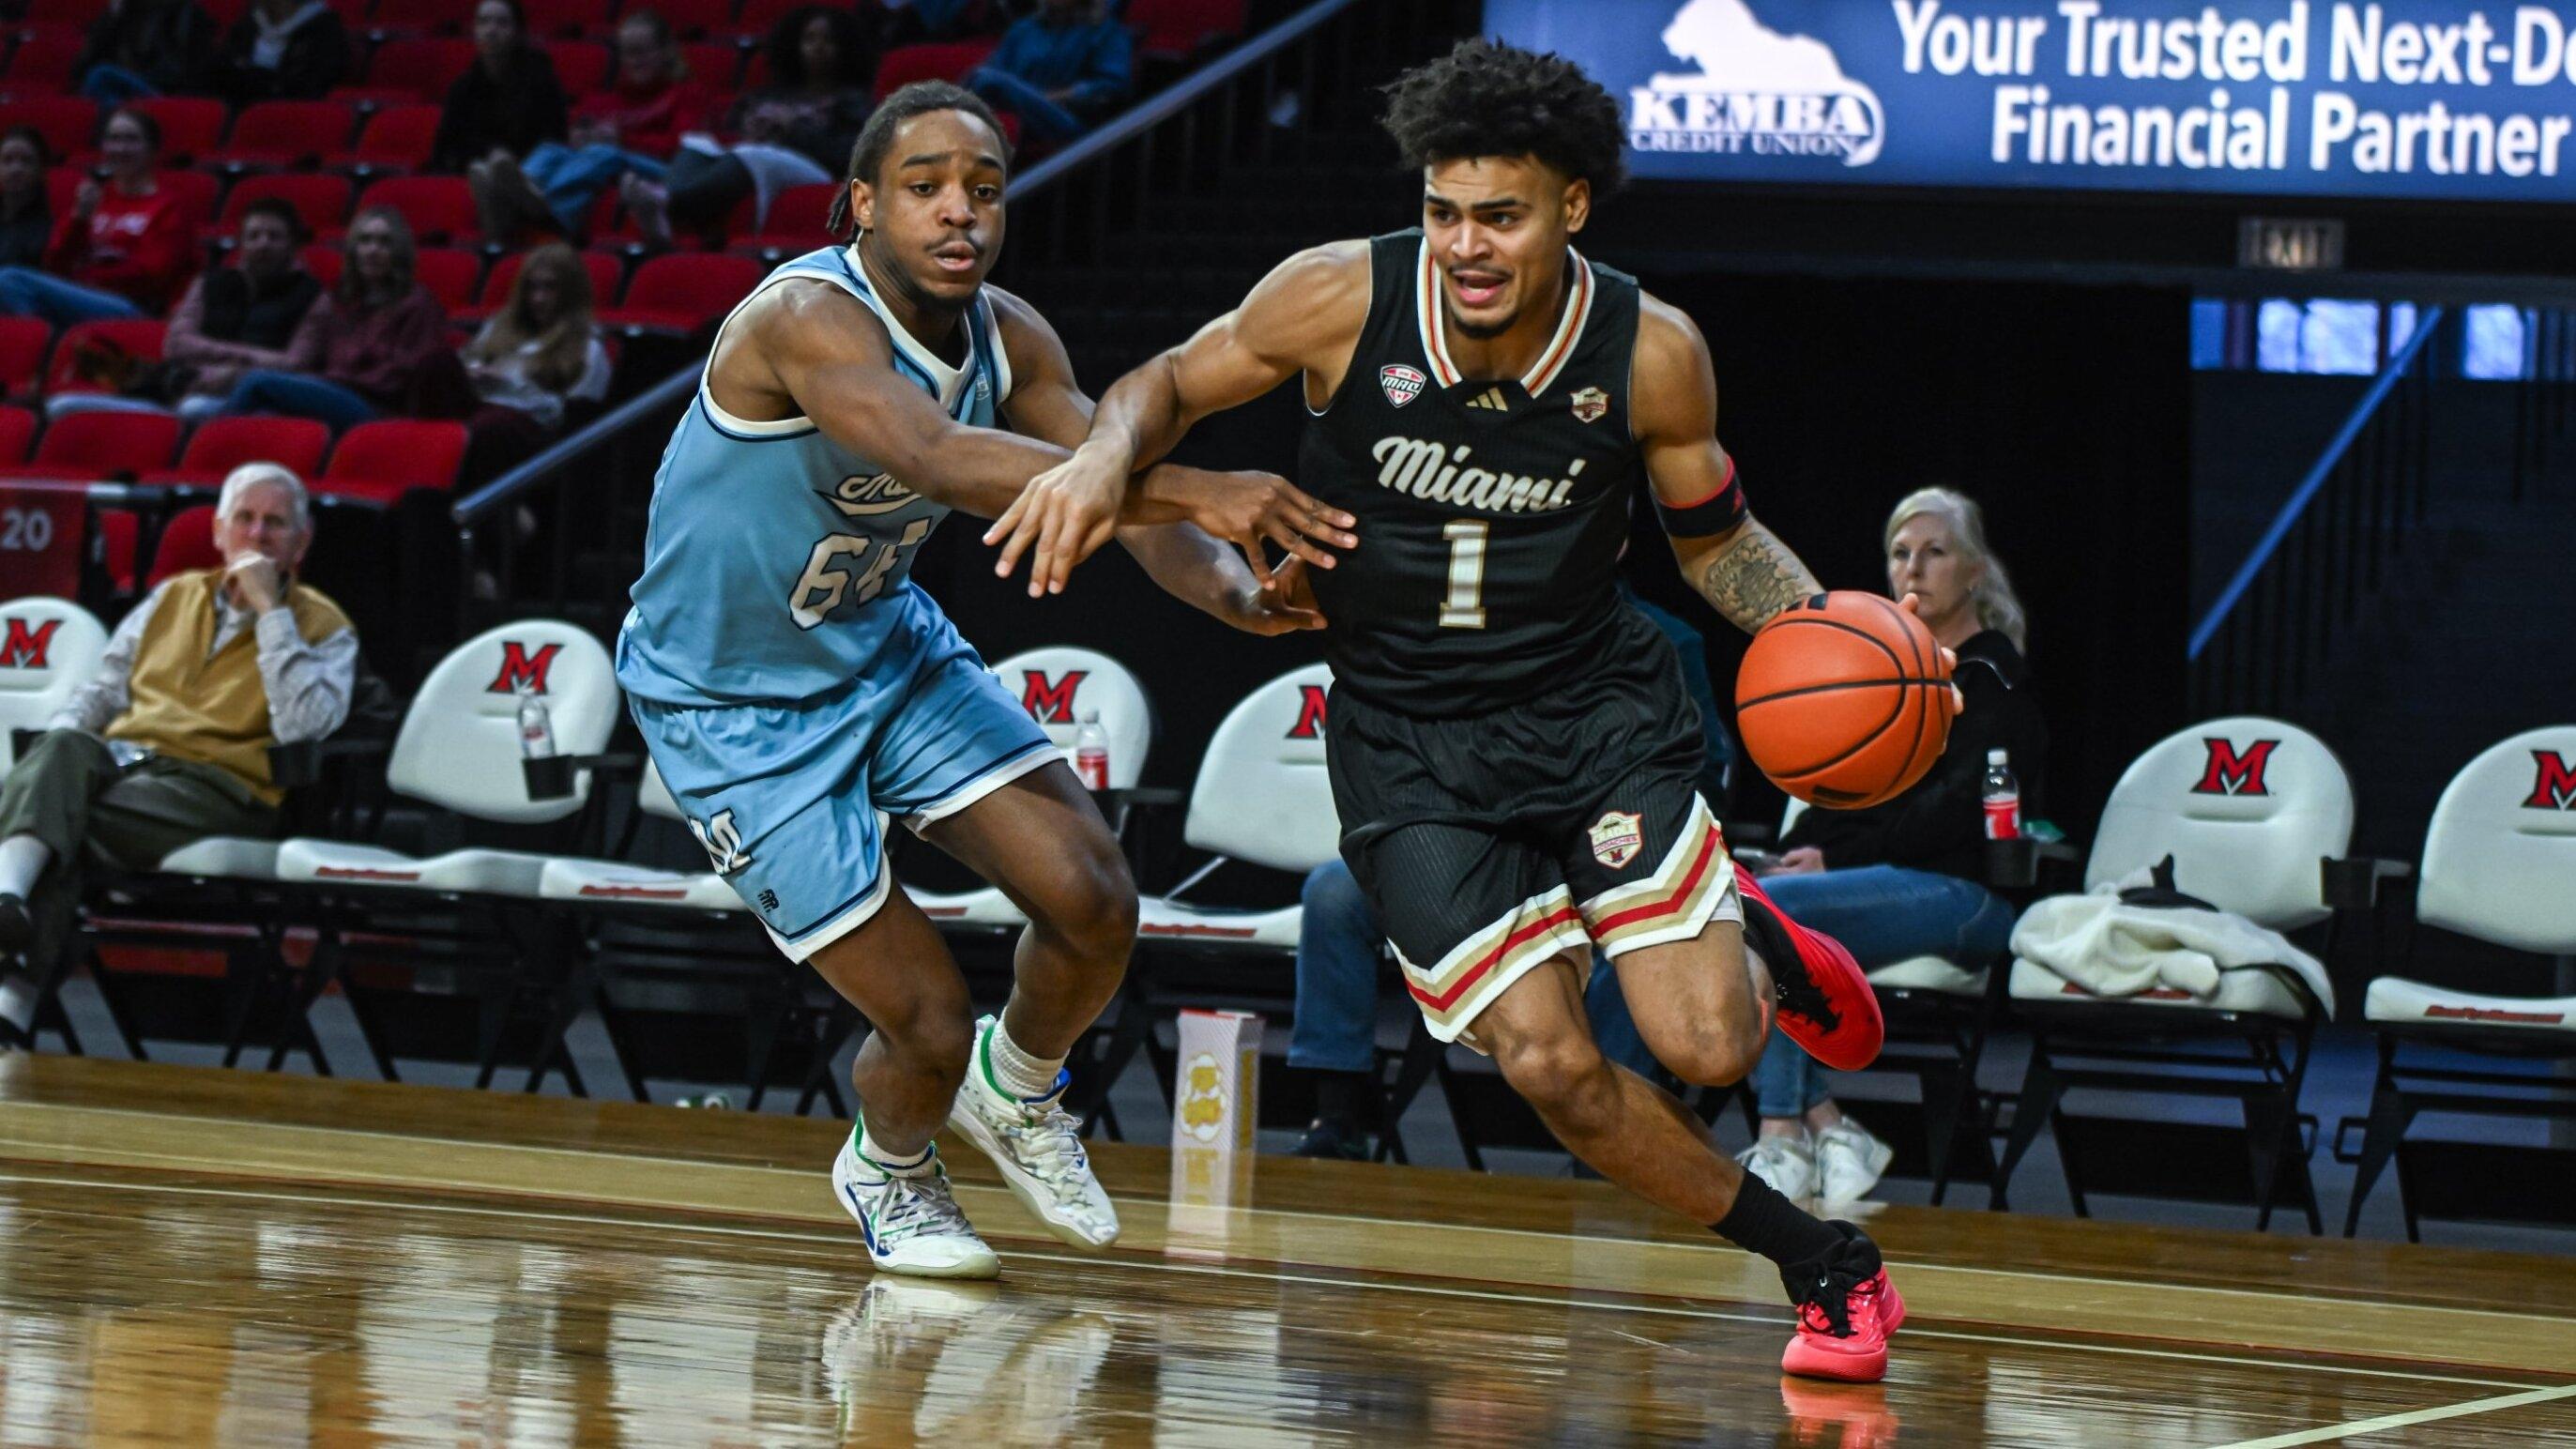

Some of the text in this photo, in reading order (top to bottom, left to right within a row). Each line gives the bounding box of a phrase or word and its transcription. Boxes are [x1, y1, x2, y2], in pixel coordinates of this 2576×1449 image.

[1891, 0, 2047, 76] Your
[2057, 0, 2309, 83] Trusted
[1630, 86, 1870, 137] KEMBA
[1990, 84, 2571, 177] Financial Partner
[1631, 131, 1860, 158] CREDIT UNION
[1382, 375, 1422, 393] MAC
[1372, 435, 1586, 513] Miami
[0, 507, 53, 552] 20
[1439, 518, 1489, 629] 1
[0, 618, 65, 669] M
[485, 641, 565, 694] M
[1021, 669, 1090, 724] M
[2189, 737, 2281, 797] M
[2520, 750, 2576, 812] M
